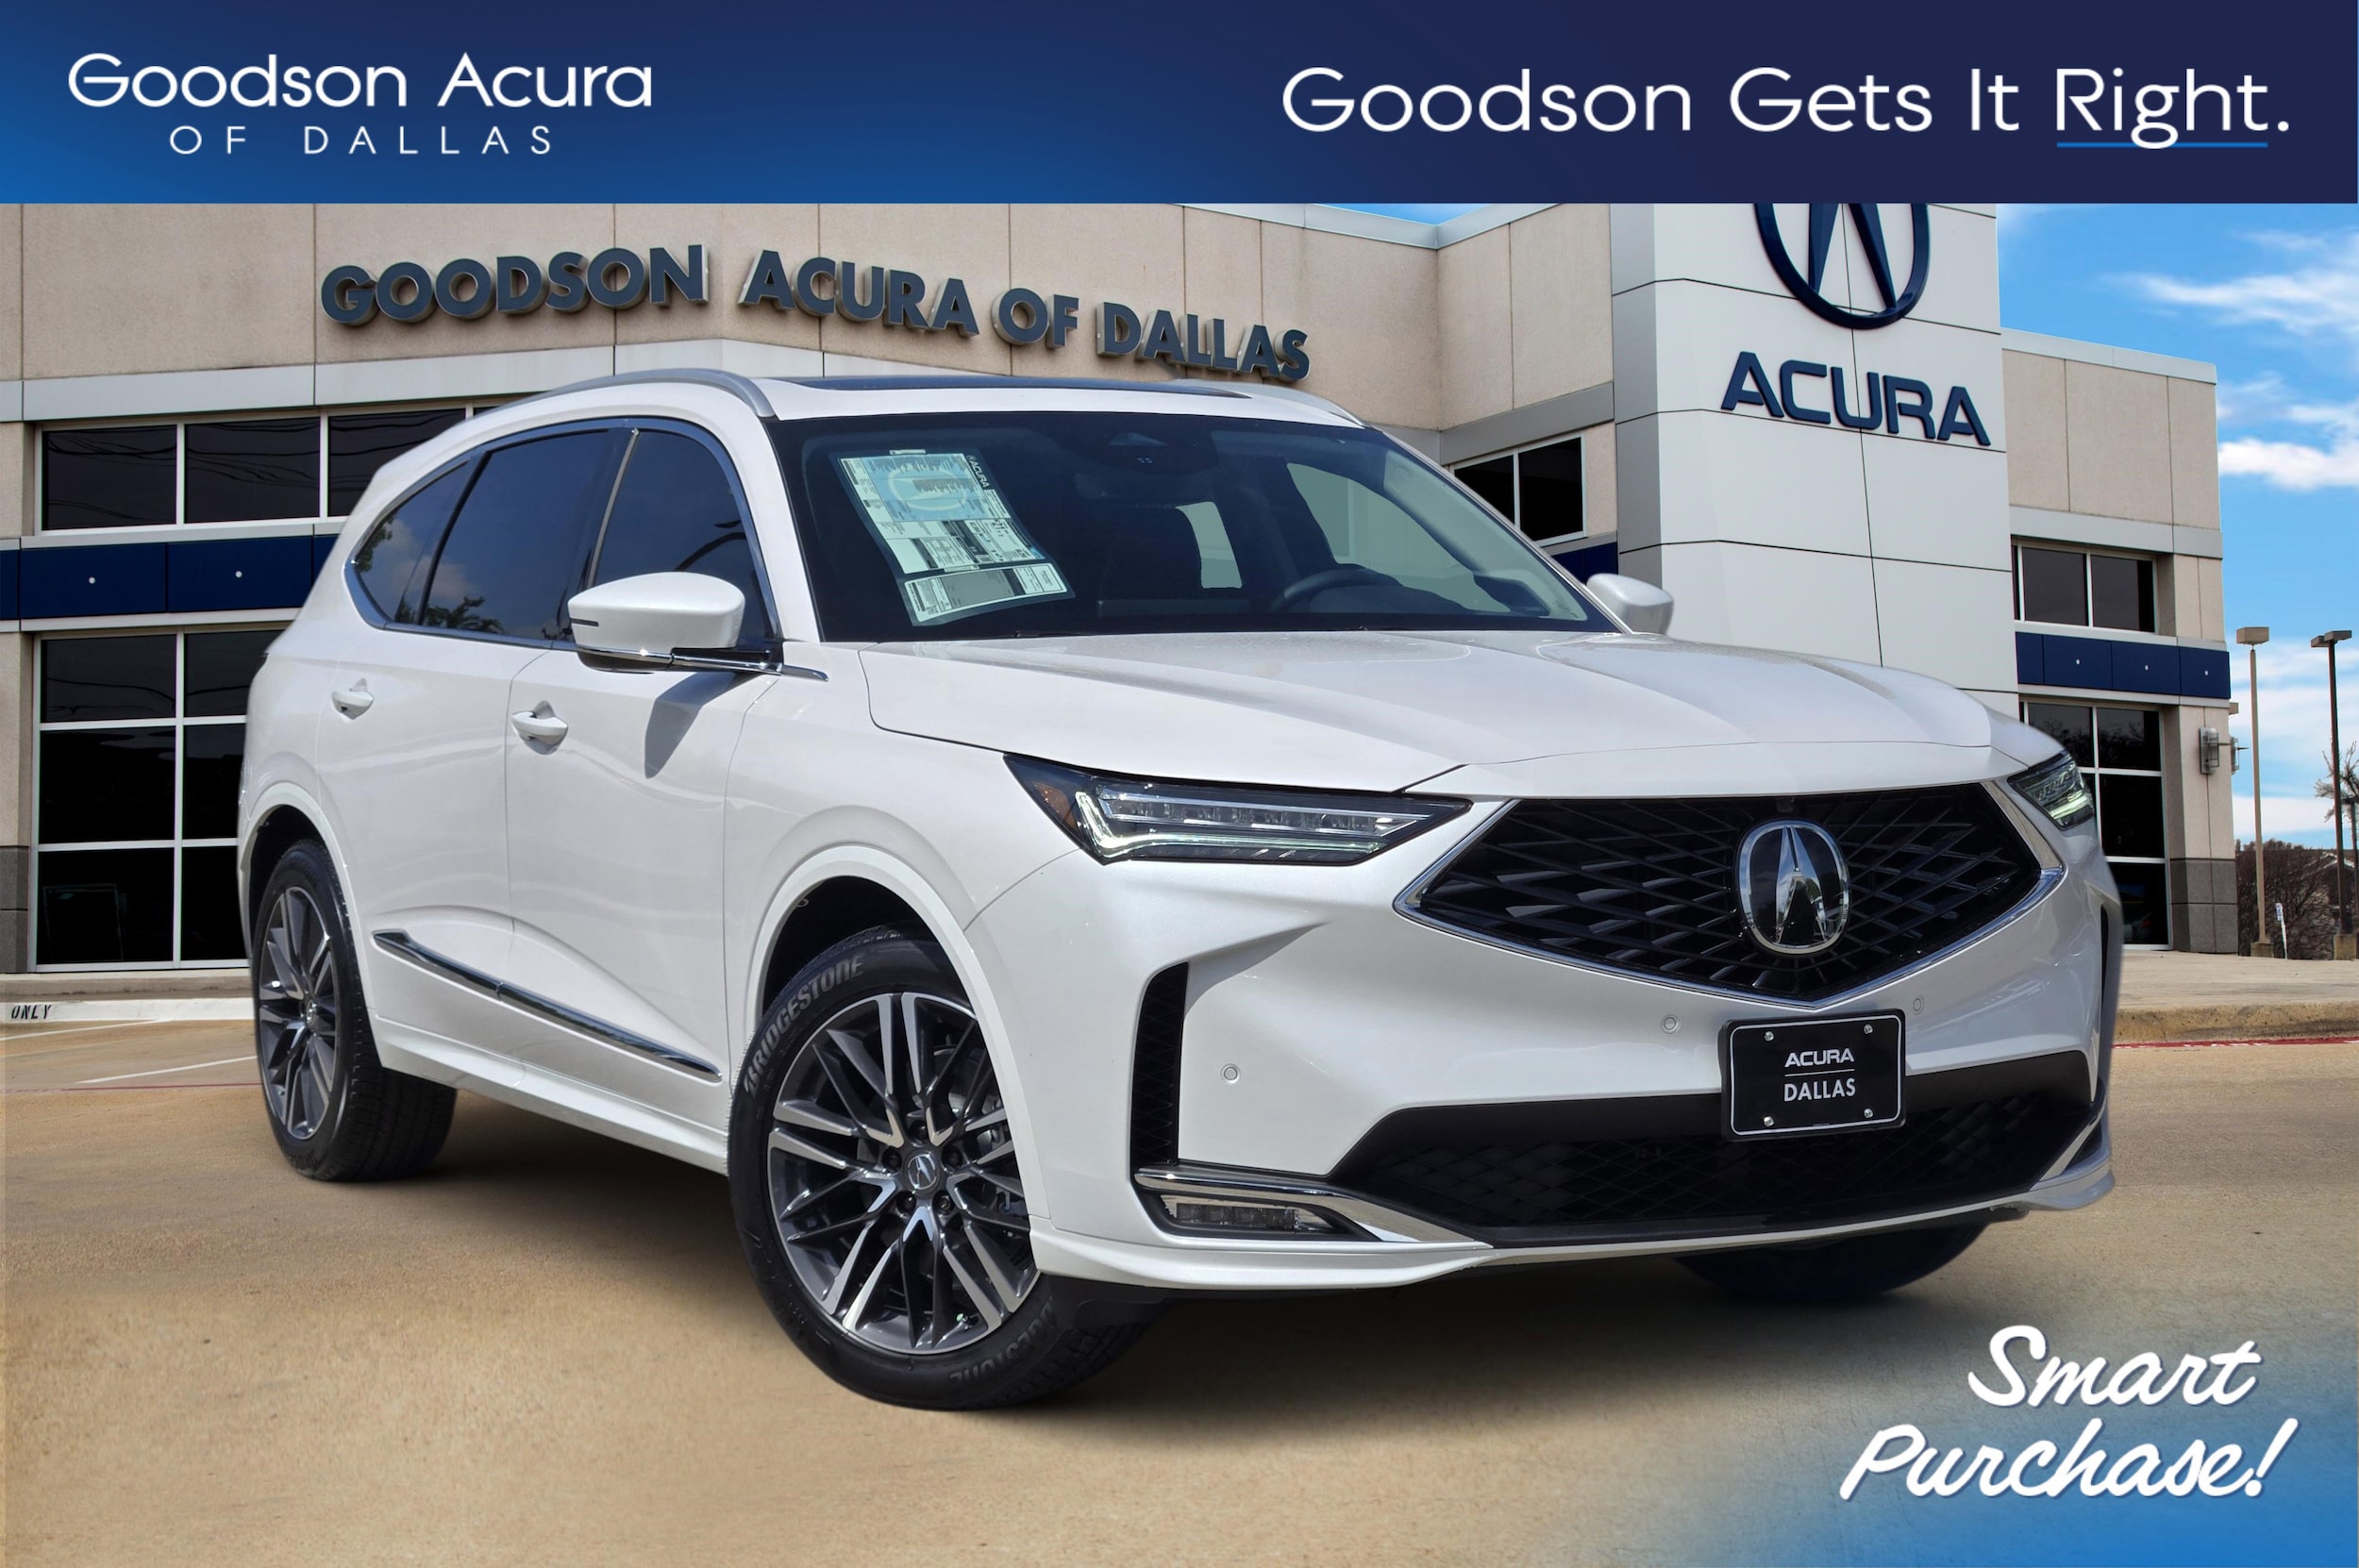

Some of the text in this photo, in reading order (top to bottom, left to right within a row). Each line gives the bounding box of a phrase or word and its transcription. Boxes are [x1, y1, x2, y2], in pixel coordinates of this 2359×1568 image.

[321, 243, 1311, 382] GOODSON ACURA OF DALLAS
[1721, 351, 1991, 446] ACURA
[969, 460, 990, 488] ACURA
[11, 1004, 52, 1020] ONLY
[743, 955, 865, 1099] BRIDGESTONE
[1784, 1047, 1855, 1068] ACURA
[1784, 1077, 1856, 1102] DALLAS
